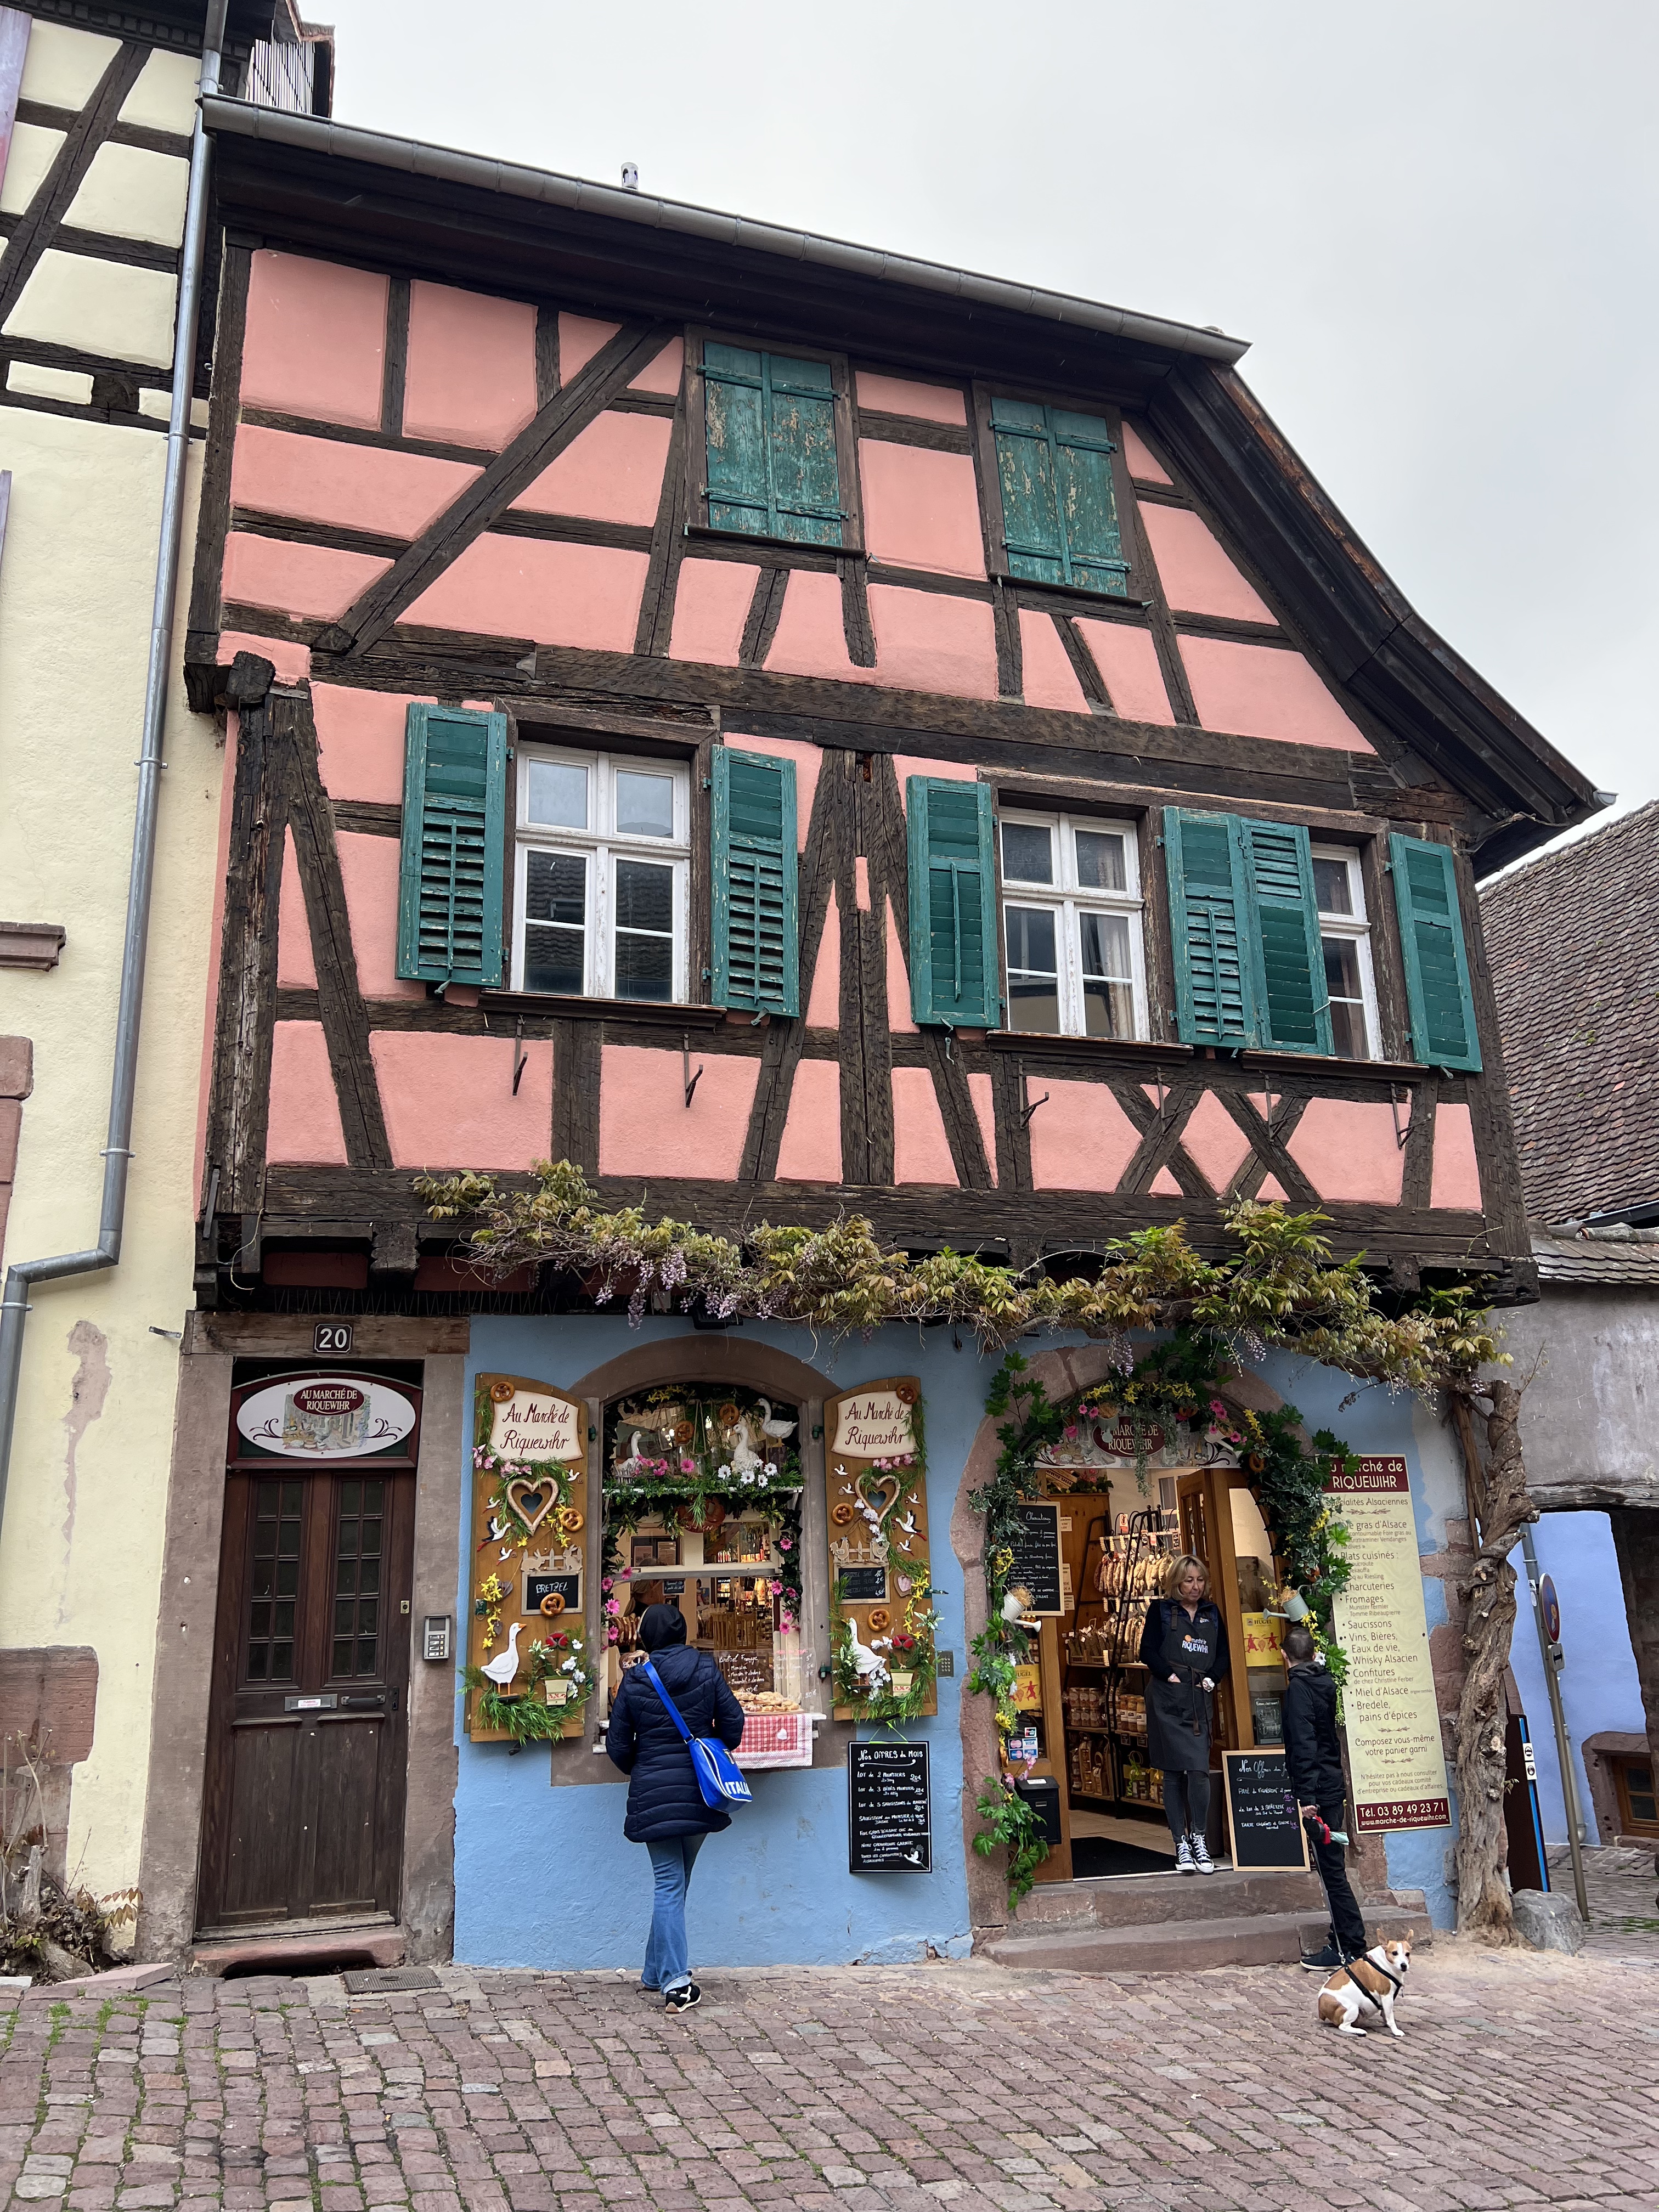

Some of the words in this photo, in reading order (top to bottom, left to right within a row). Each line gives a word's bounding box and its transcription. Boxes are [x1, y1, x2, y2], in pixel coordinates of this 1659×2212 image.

[319, 1328, 347, 1348] 20
[300, 1390, 312, 1399] AU
[313, 1387, 346, 1400] MARCHÉ
[347, 1390, 357, 1400] DE
[306, 1401, 350, 1414] RIQUEWIHR
[502, 1403, 522, 1423] Au
[523, 1403, 558, 1423] Marché
[558, 1404, 569, 1424] de
[845, 1402, 862, 1420] Au
[864, 1401, 894, 1420] Marché
[895, 1402, 904, 1420] de
[1148, 1425, 1159, 1436] DE
[500, 1429, 571, 1457] Riquewihr
[845, 1426, 906, 1451] Riquewihr
[1388, 1460, 1403, 1472] de
[1333, 1475, 1397, 1489] RIQUEWIHR
[1365, 1497, 1408, 1506] Alsaciennes
[1356, 1522, 1373, 1531] gras
[1375, 1520, 1407, 1528] d'Alsace
[1362, 1551, 1395, 1560] cuisinés
[536, 1581, 568, 1594] BRETZEL
[1344, 1582, 1395, 1591] Charcuteries
[1345, 1595, 1384, 1605] Fromages
[1348, 1620, 1392, 1629] Saucissons
[1348, 1632, 1369, 1642] Vins,
[1371, 1632, 1398, 1641] Bières,
[1352, 1645, 1371, 1653] Eaux
[1373, 1644, 1384, 1652] de
[1385, 1643, 1400, 1652] vie,
[1352, 1655, 1383, 1666] Whisky
[1385, 1654, 1418, 1663] Alsacien
[1353, 1668, 1395, 1678] Confitures
[1356, 1687, 1373, 1696] Miel
[1375, 1686, 1408, 1696] d'Alsace
[1357, 1700, 1391, 1709] Bredele,
[1359, 1712, 1381, 1724] pains
[1384, 1711, 1417, 1722] d'épices
[1355, 1737, 1392, 1747] Composez
[1393, 1734, 1435, 1745] vous-même
[857, 1749, 872, 1761] Nos
[874, 1750, 898, 1759] OFFRES
[1385, 1747, 1408, 1757] panier
[1409, 1744, 1427, 1755] garni
[1239, 1759, 1252, 1773] Nos
[1253, 1760, 1271, 1779] Offres
[1360, 1807, 1376, 1818] Tél.
[1377, 1806, 1390, 1816] 03
[1392, 1805, 1403, 1815] 89
[1407, 1804, 1418, 1814] 49
[1420, 1803, 1431, 1813] 23
